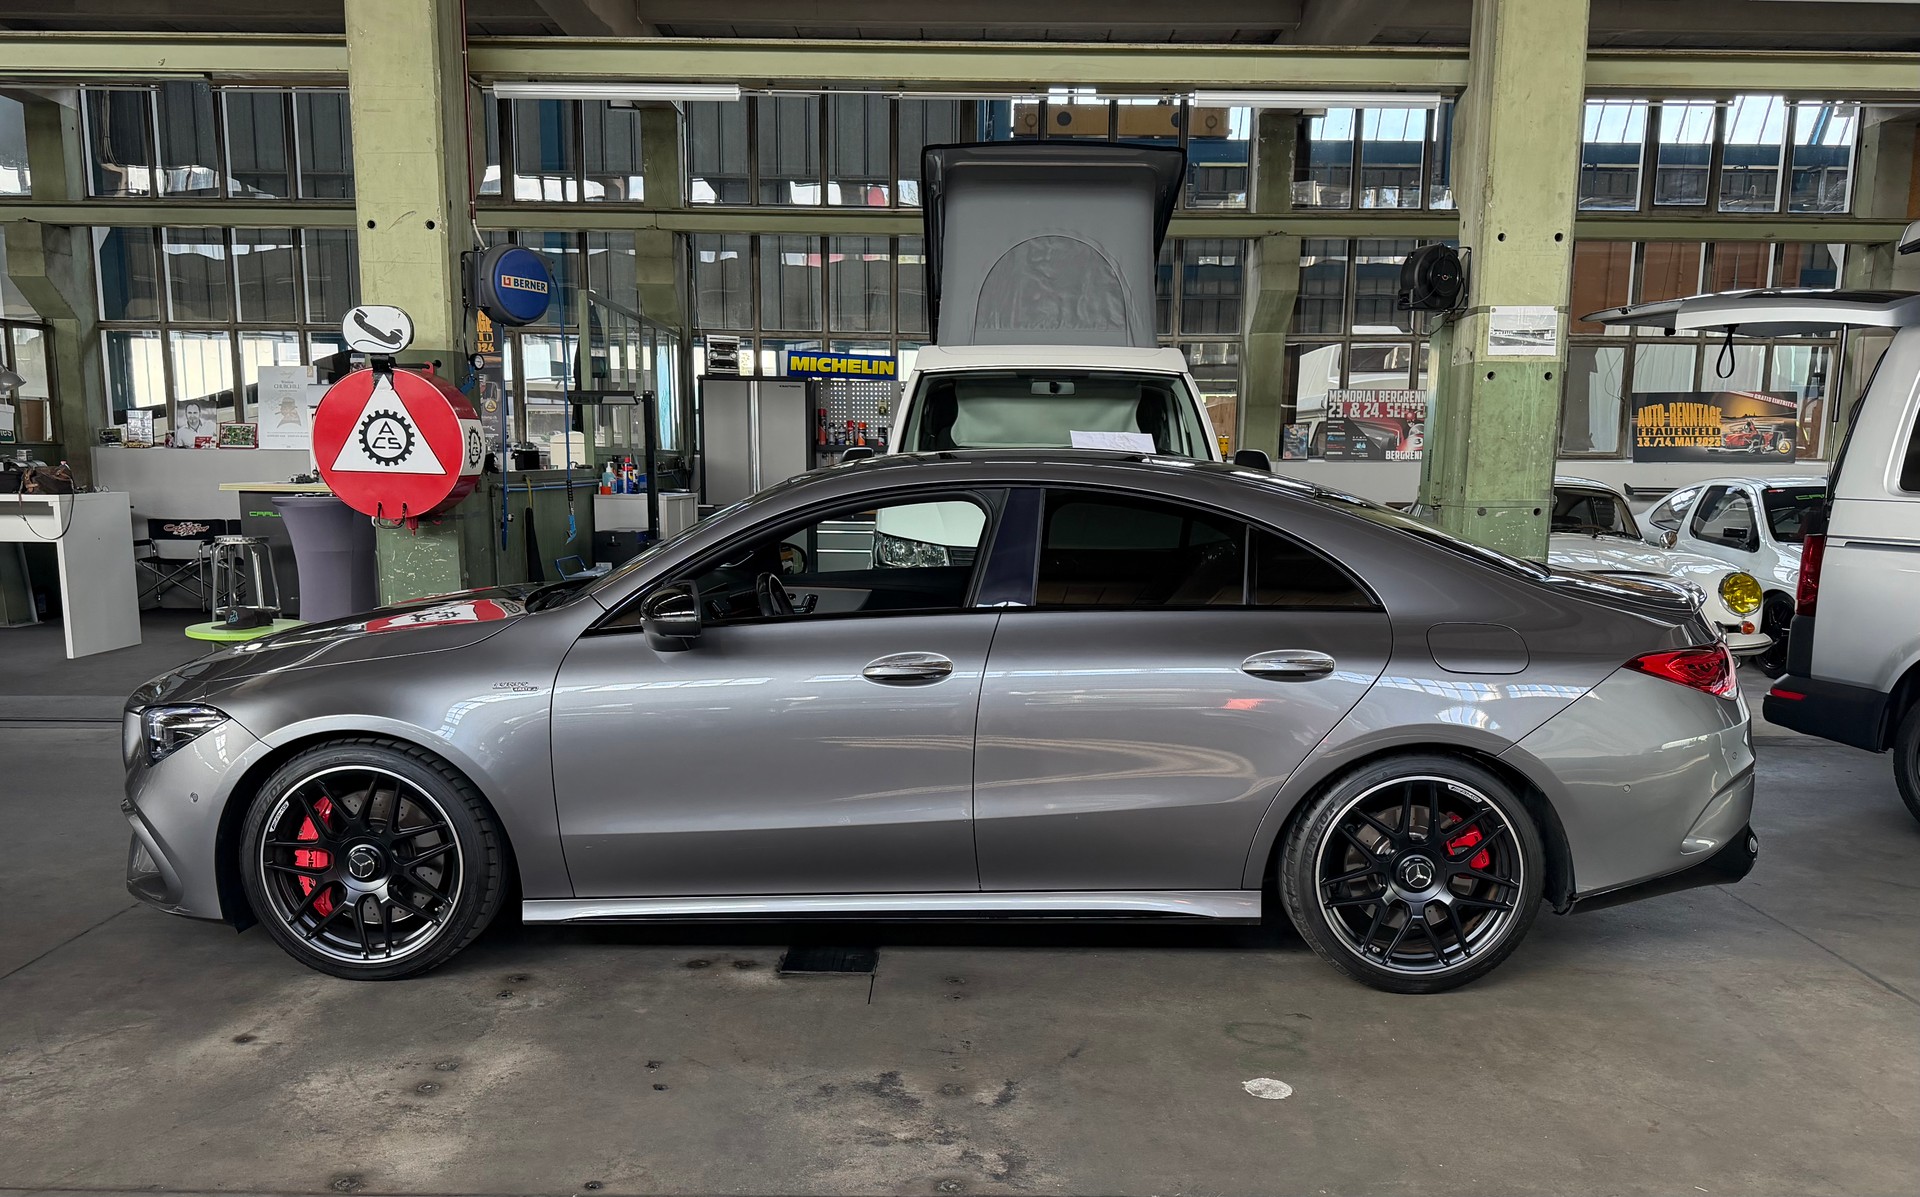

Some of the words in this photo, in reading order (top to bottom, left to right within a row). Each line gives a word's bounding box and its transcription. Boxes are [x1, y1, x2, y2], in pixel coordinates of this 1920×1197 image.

[513, 277, 546, 292] BERNER
[790, 356, 895, 375] MICHELIN
[1328, 390, 1377, 402] MEMORIAL
[1328, 403, 1347, 418] 23.
[1350, 403, 1360, 418] &
[1363, 403, 1383, 418] 24.
[1386, 403, 1426, 418] SEPTE
[1637, 402, 1722, 427] AUTO-RENNTAGE
[1638, 427, 1721, 436] FRAUENFELD
[1696, 437, 1722, 447] 2023
[1385, 450, 1423, 460] BERGREN
